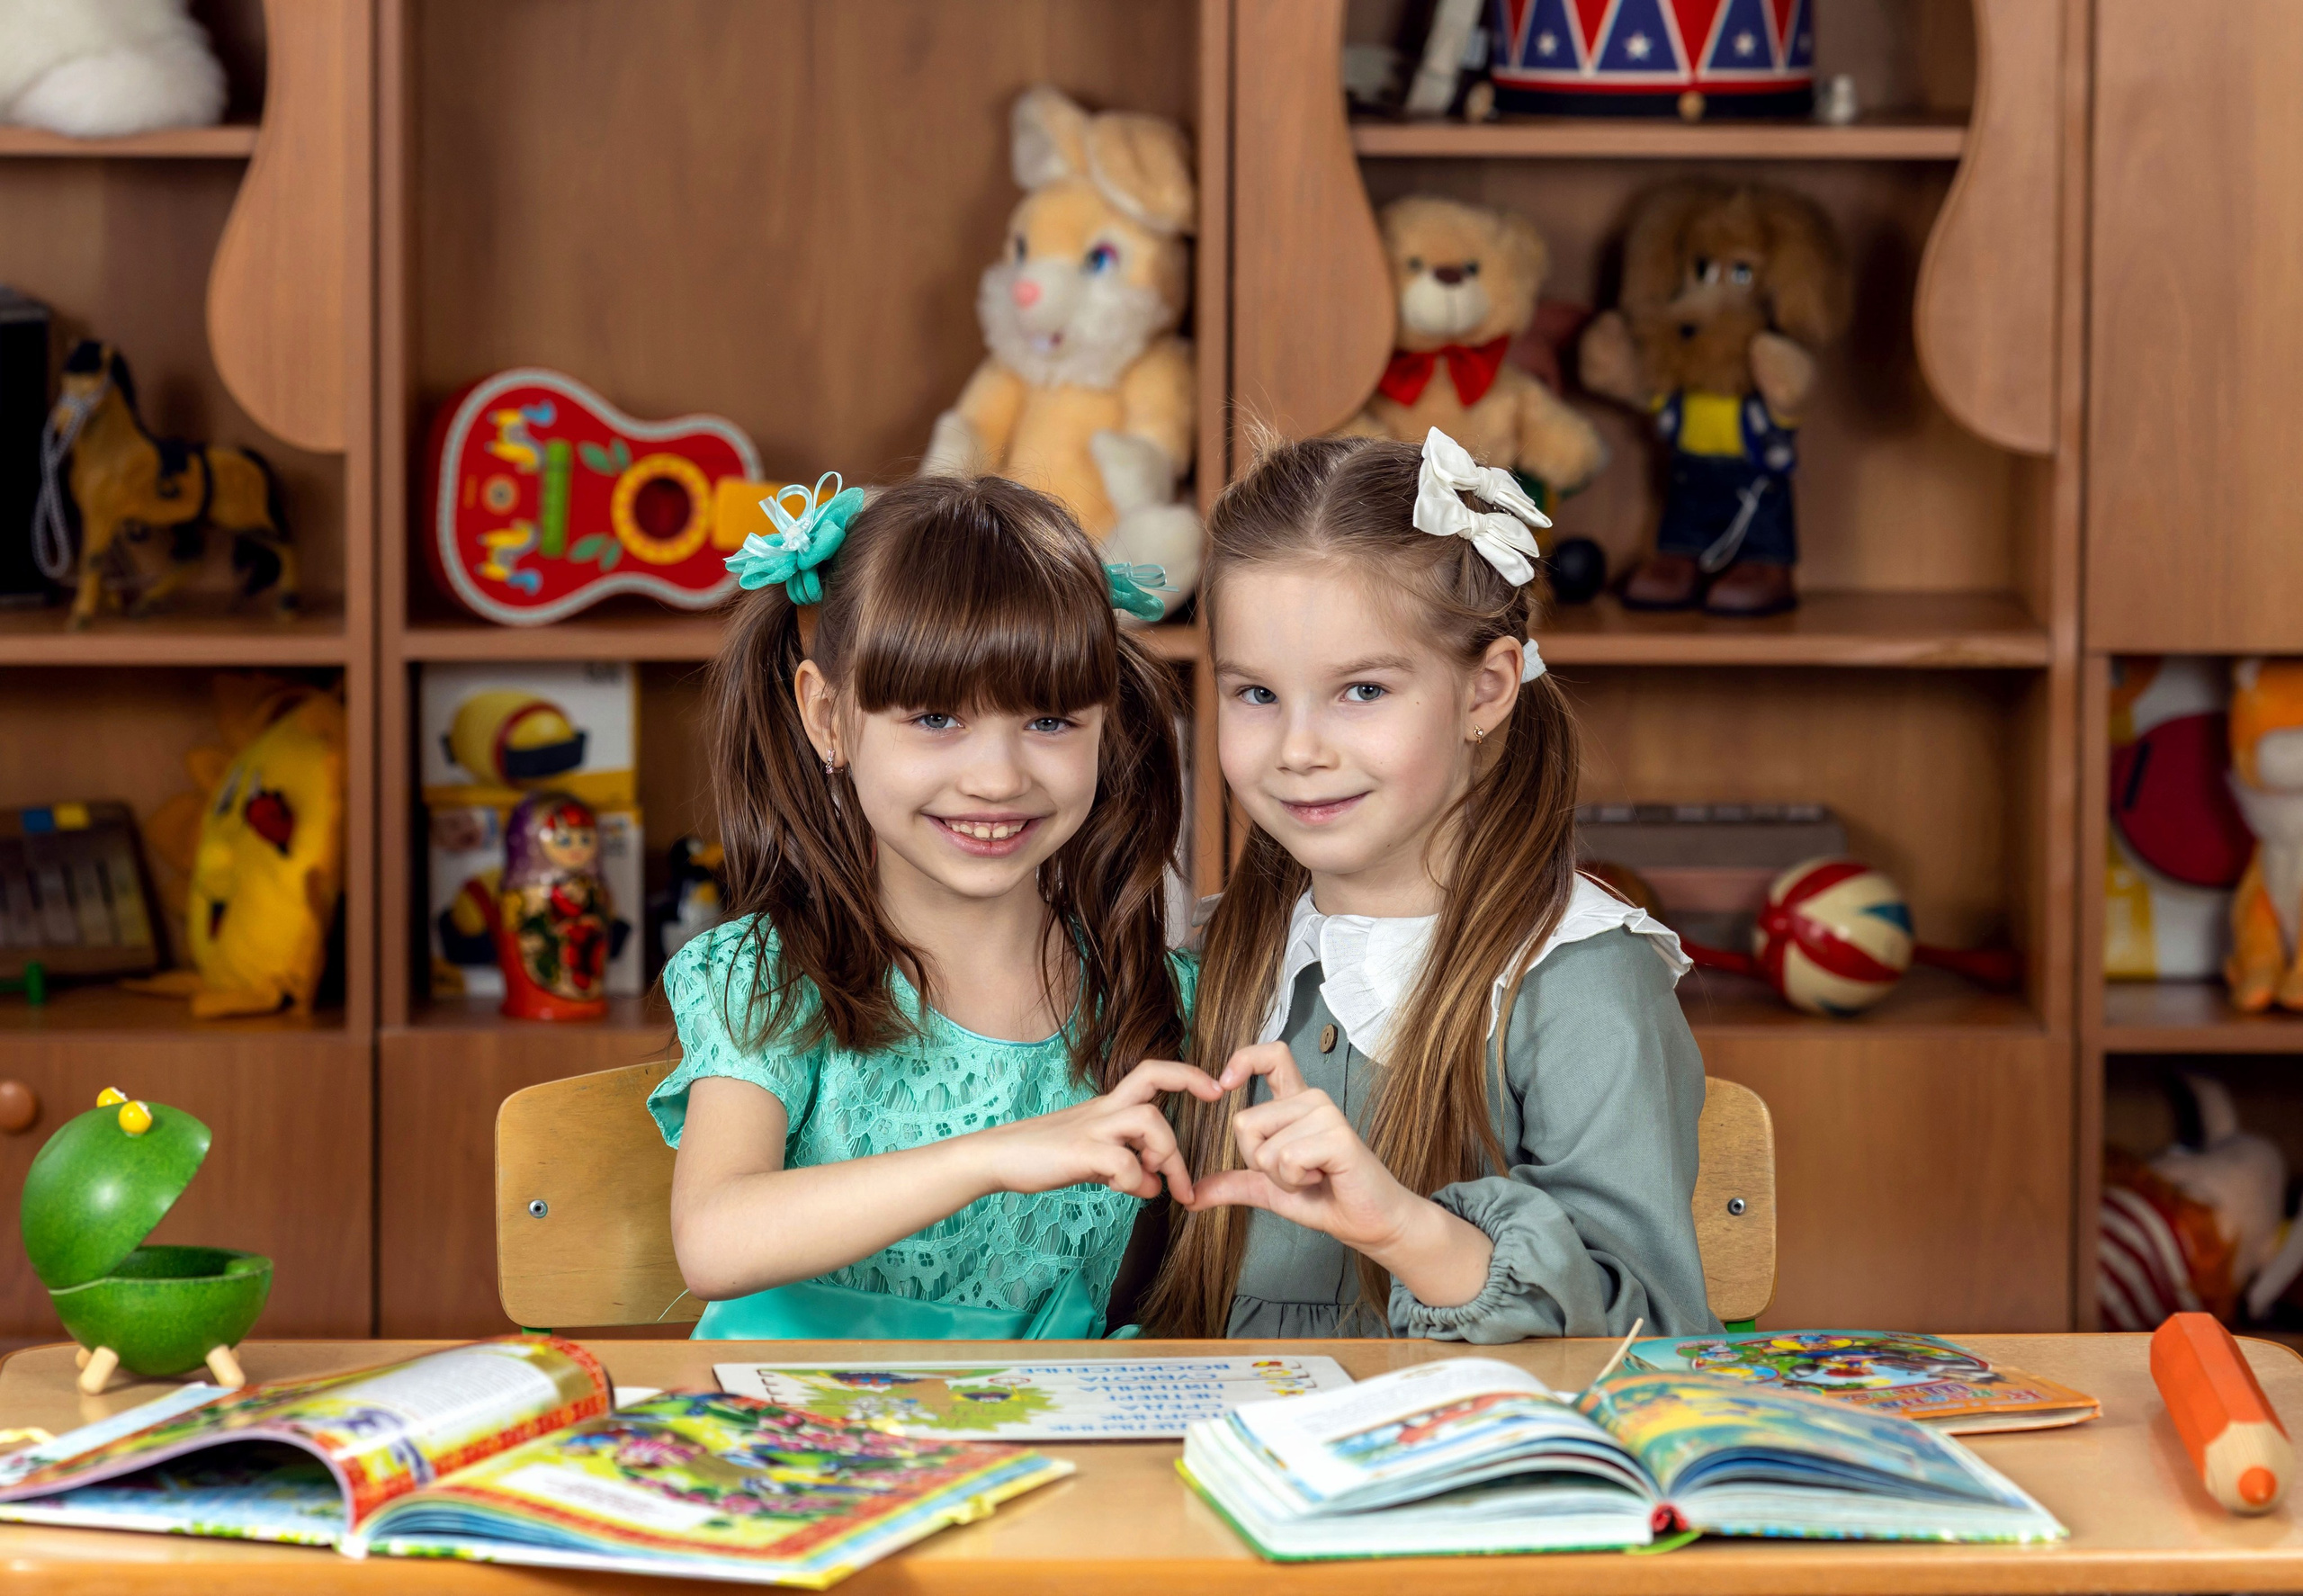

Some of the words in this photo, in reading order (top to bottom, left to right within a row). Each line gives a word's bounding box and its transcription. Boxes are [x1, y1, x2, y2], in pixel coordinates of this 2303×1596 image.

[1019, 1363, 1231, 1376] ВОСКРЕСЕНЬЕ
[1076, 1373, 1218, 1384] СУББОТА
[1076, 1383, 1224, 1394] ПЯТНИЦА
[1118, 1403, 1223, 1412] СРЕДА
[1099, 1412, 1222, 1421] ТОРНИК
